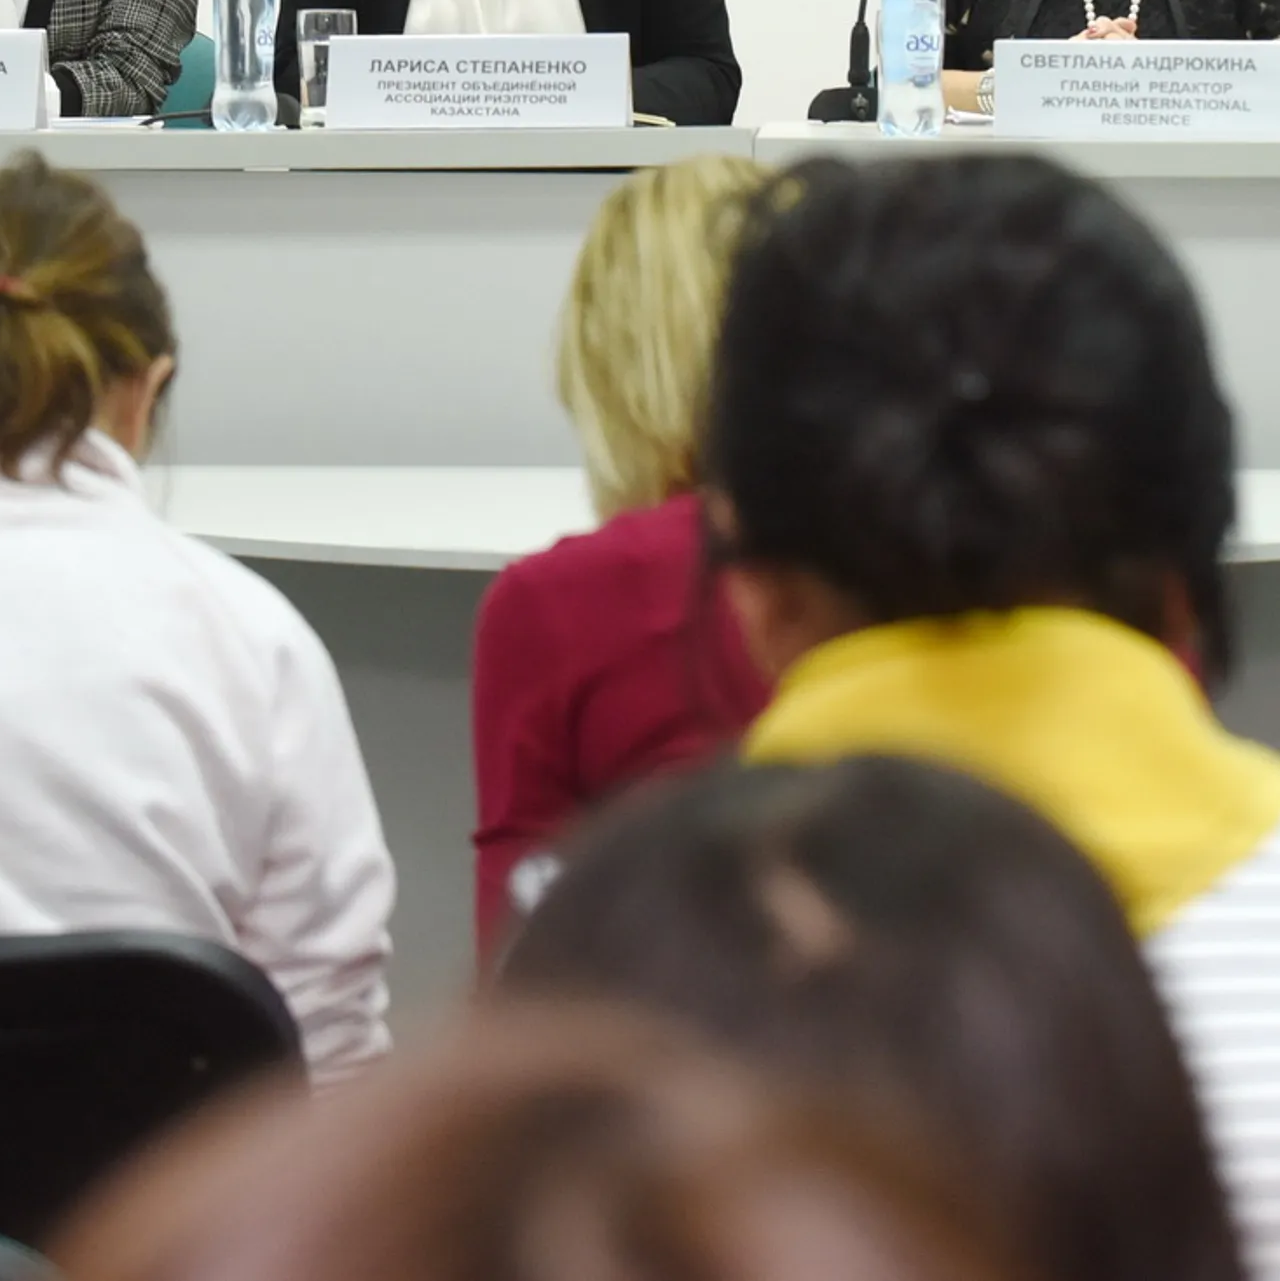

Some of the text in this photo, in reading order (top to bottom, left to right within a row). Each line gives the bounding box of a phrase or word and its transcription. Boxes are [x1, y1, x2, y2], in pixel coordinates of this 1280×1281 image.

[906, 33, 940, 52] asu
[370, 60, 586, 74] ЛАРИСА СТЕПАНЕНКО
[1020, 54, 1257, 72] СВЕТЛАНА АНДРЮКИНА
[378, 80, 576, 92] ПРЕЗИДЕНТ ОБЪЕДИНЁННОЙ
[1060, 79, 1233, 94] ГЛАВНЫЙ РЕДАКТОР
[385, 94, 567, 105] АССОЦИАЦИИ РИЭЛТОРОВ
[1042, 97, 1251, 111] ЖУРНАЛА INTERNATIONAL
[430, 107, 520, 116] КАЗАХСТАНА
[1101, 115, 1191, 125] RESIDENCE
